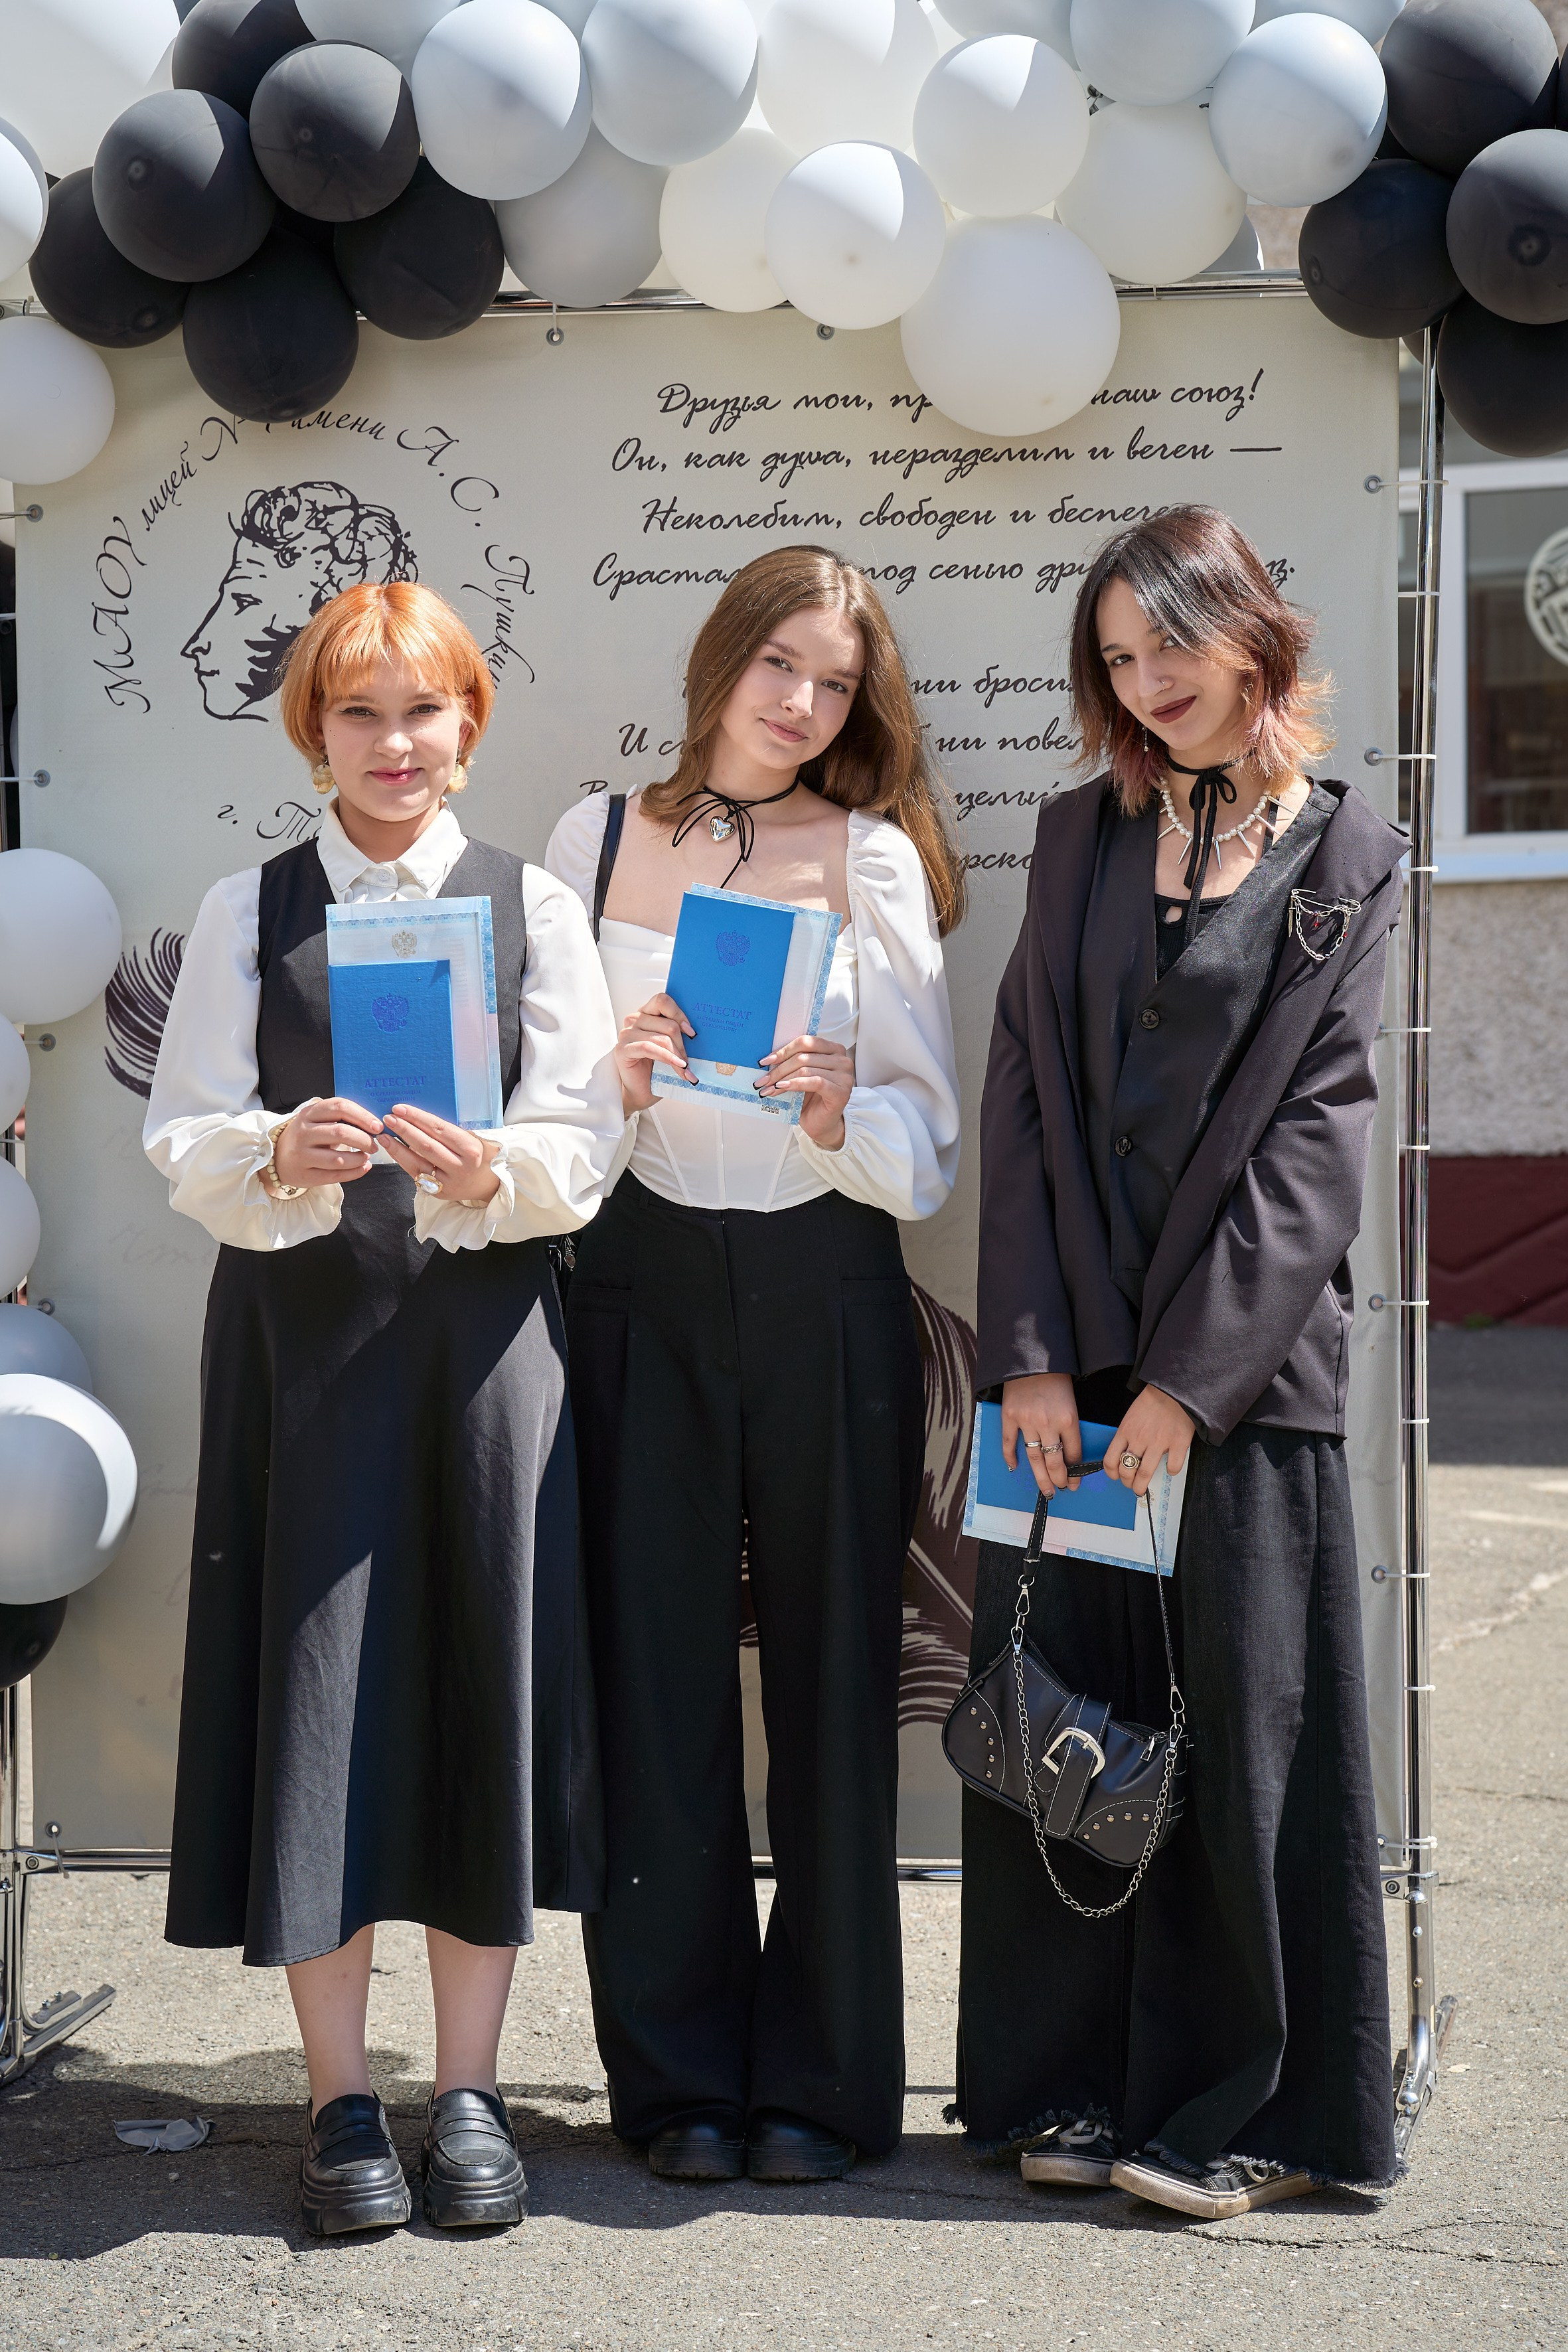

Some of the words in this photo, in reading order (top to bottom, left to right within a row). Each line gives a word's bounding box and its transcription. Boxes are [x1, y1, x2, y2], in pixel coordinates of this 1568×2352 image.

[657, 383, 781, 434] Друзья
[793, 394, 874, 411] мои,
[1170, 368, 1265, 422] союз!
[611, 437, 667, 472] Он,
[684, 451, 751, 469] как
[760, 450, 852, 489] душа,
[868, 447, 1075, 484] неразделим
[1088, 447, 1115, 461] и
[1127, 426, 1214, 460] вечен
[641, 496, 842, 534] Неколебим,
[859, 492, 996, 540] свободен
[1010, 509, 1036, 524] и
[92, 516, 150, 713] МАОУ
[145, 441, 197, 531] лицей
[291, 410, 386, 439] имени
[929, 562, 1024, 580] сенью
[973, 664, 1073, 709] броси
[935, 736, 986, 752] ни
[693, 1002, 752, 1020] АТТЕСТАТ
[363, 1075, 427, 1088] АТТЕСТАТ
